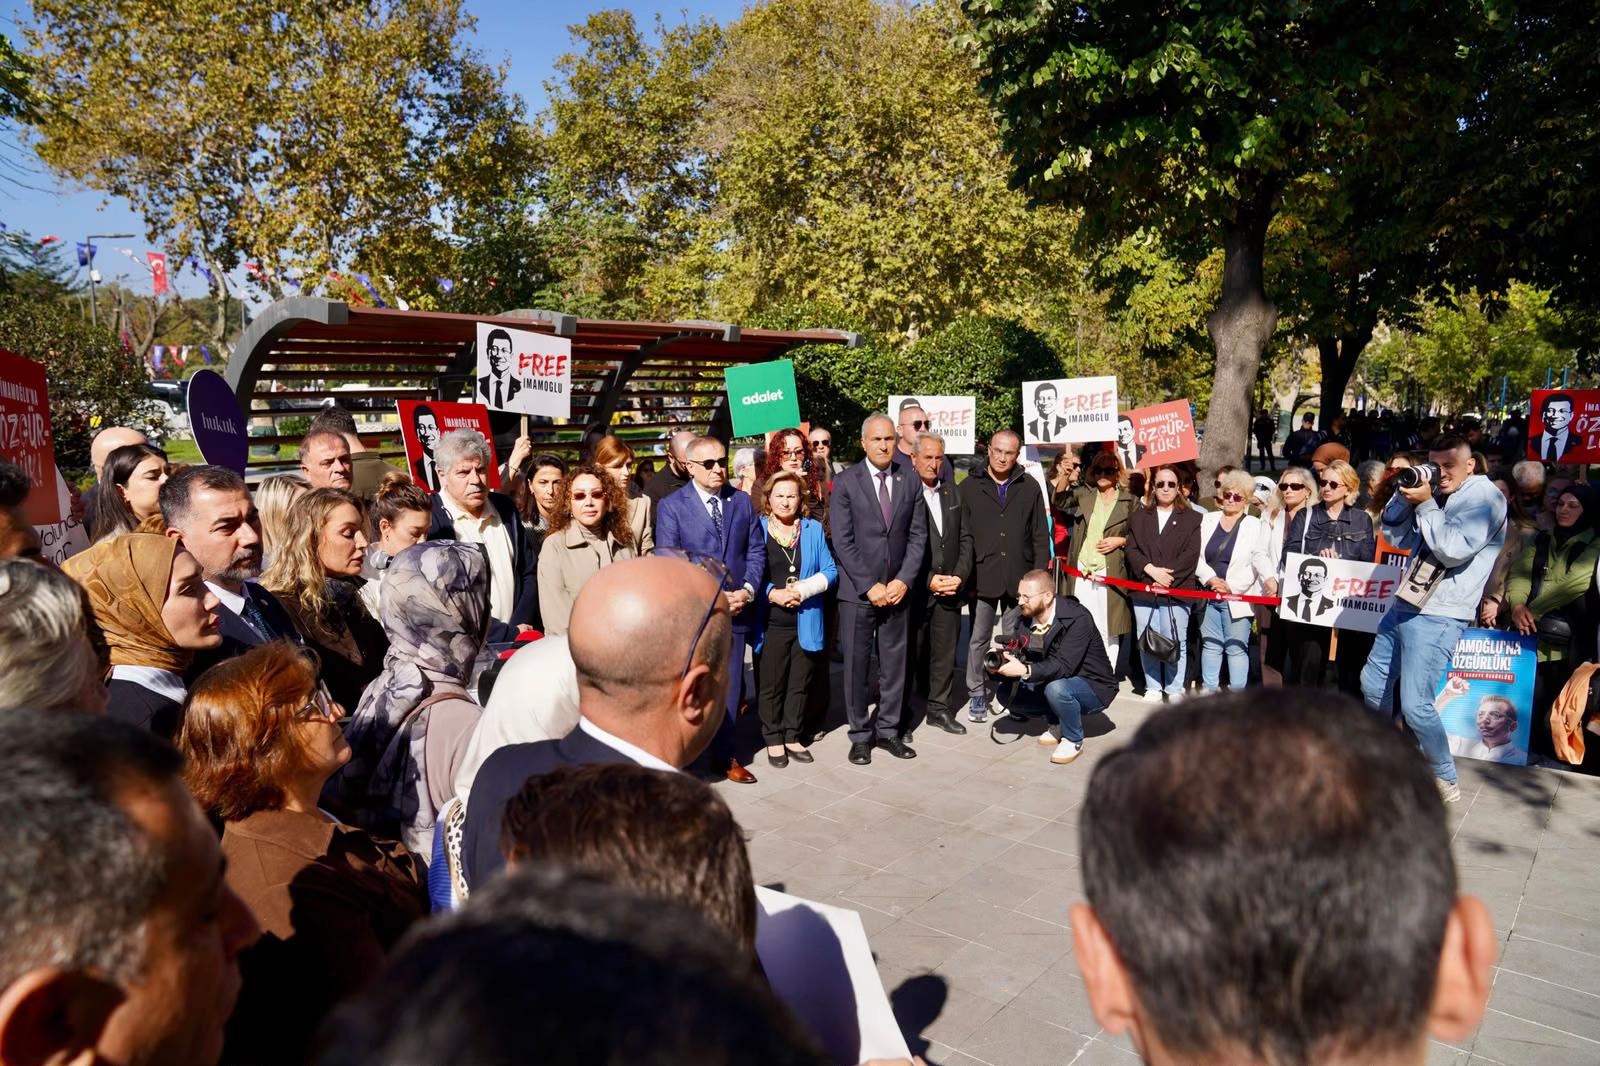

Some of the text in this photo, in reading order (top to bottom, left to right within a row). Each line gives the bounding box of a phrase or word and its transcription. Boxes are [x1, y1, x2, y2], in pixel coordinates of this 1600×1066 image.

[518, 352, 568, 377] FREE
[523, 377, 563, 394] IMAMOGLU
[742, 388, 784, 405] adalet
[1063, 389, 1113, 414] FREE
[201, 411, 238, 435] hukuk
[927, 408, 972, 427] FREE
[1068, 413, 1110, 423] IMAMOGLU
[1138, 418, 1190, 443] ÖZGÜR-
[1150, 434, 1181, 456] LÜK!
[1332, 577, 1395, 599] FREE
[1336, 598, 1386, 613] IMAMOGLU
[1452, 652, 1512, 671] ÖZGÜRLÜK!
